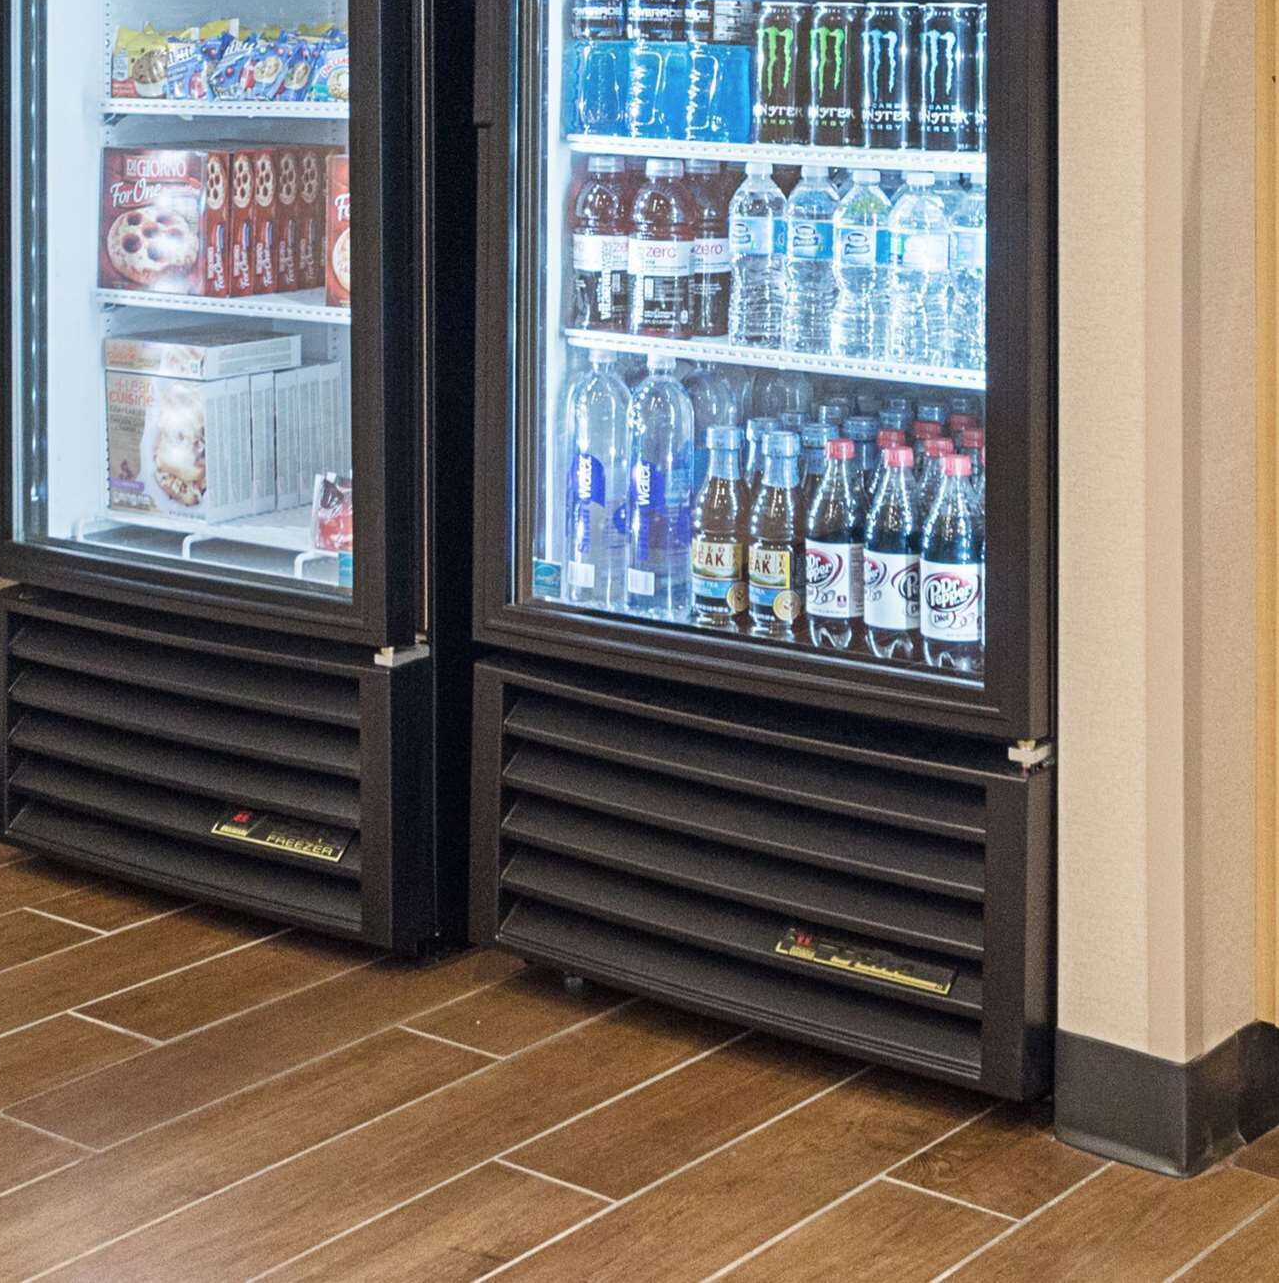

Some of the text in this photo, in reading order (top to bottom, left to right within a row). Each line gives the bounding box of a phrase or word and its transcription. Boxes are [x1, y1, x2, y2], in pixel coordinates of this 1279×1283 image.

[110, 177, 160, 207] For One
[695, 244, 723, 255] zero
[930, 579, 972, 607] Pepper
[266, 835, 333, 856] FREEZER
